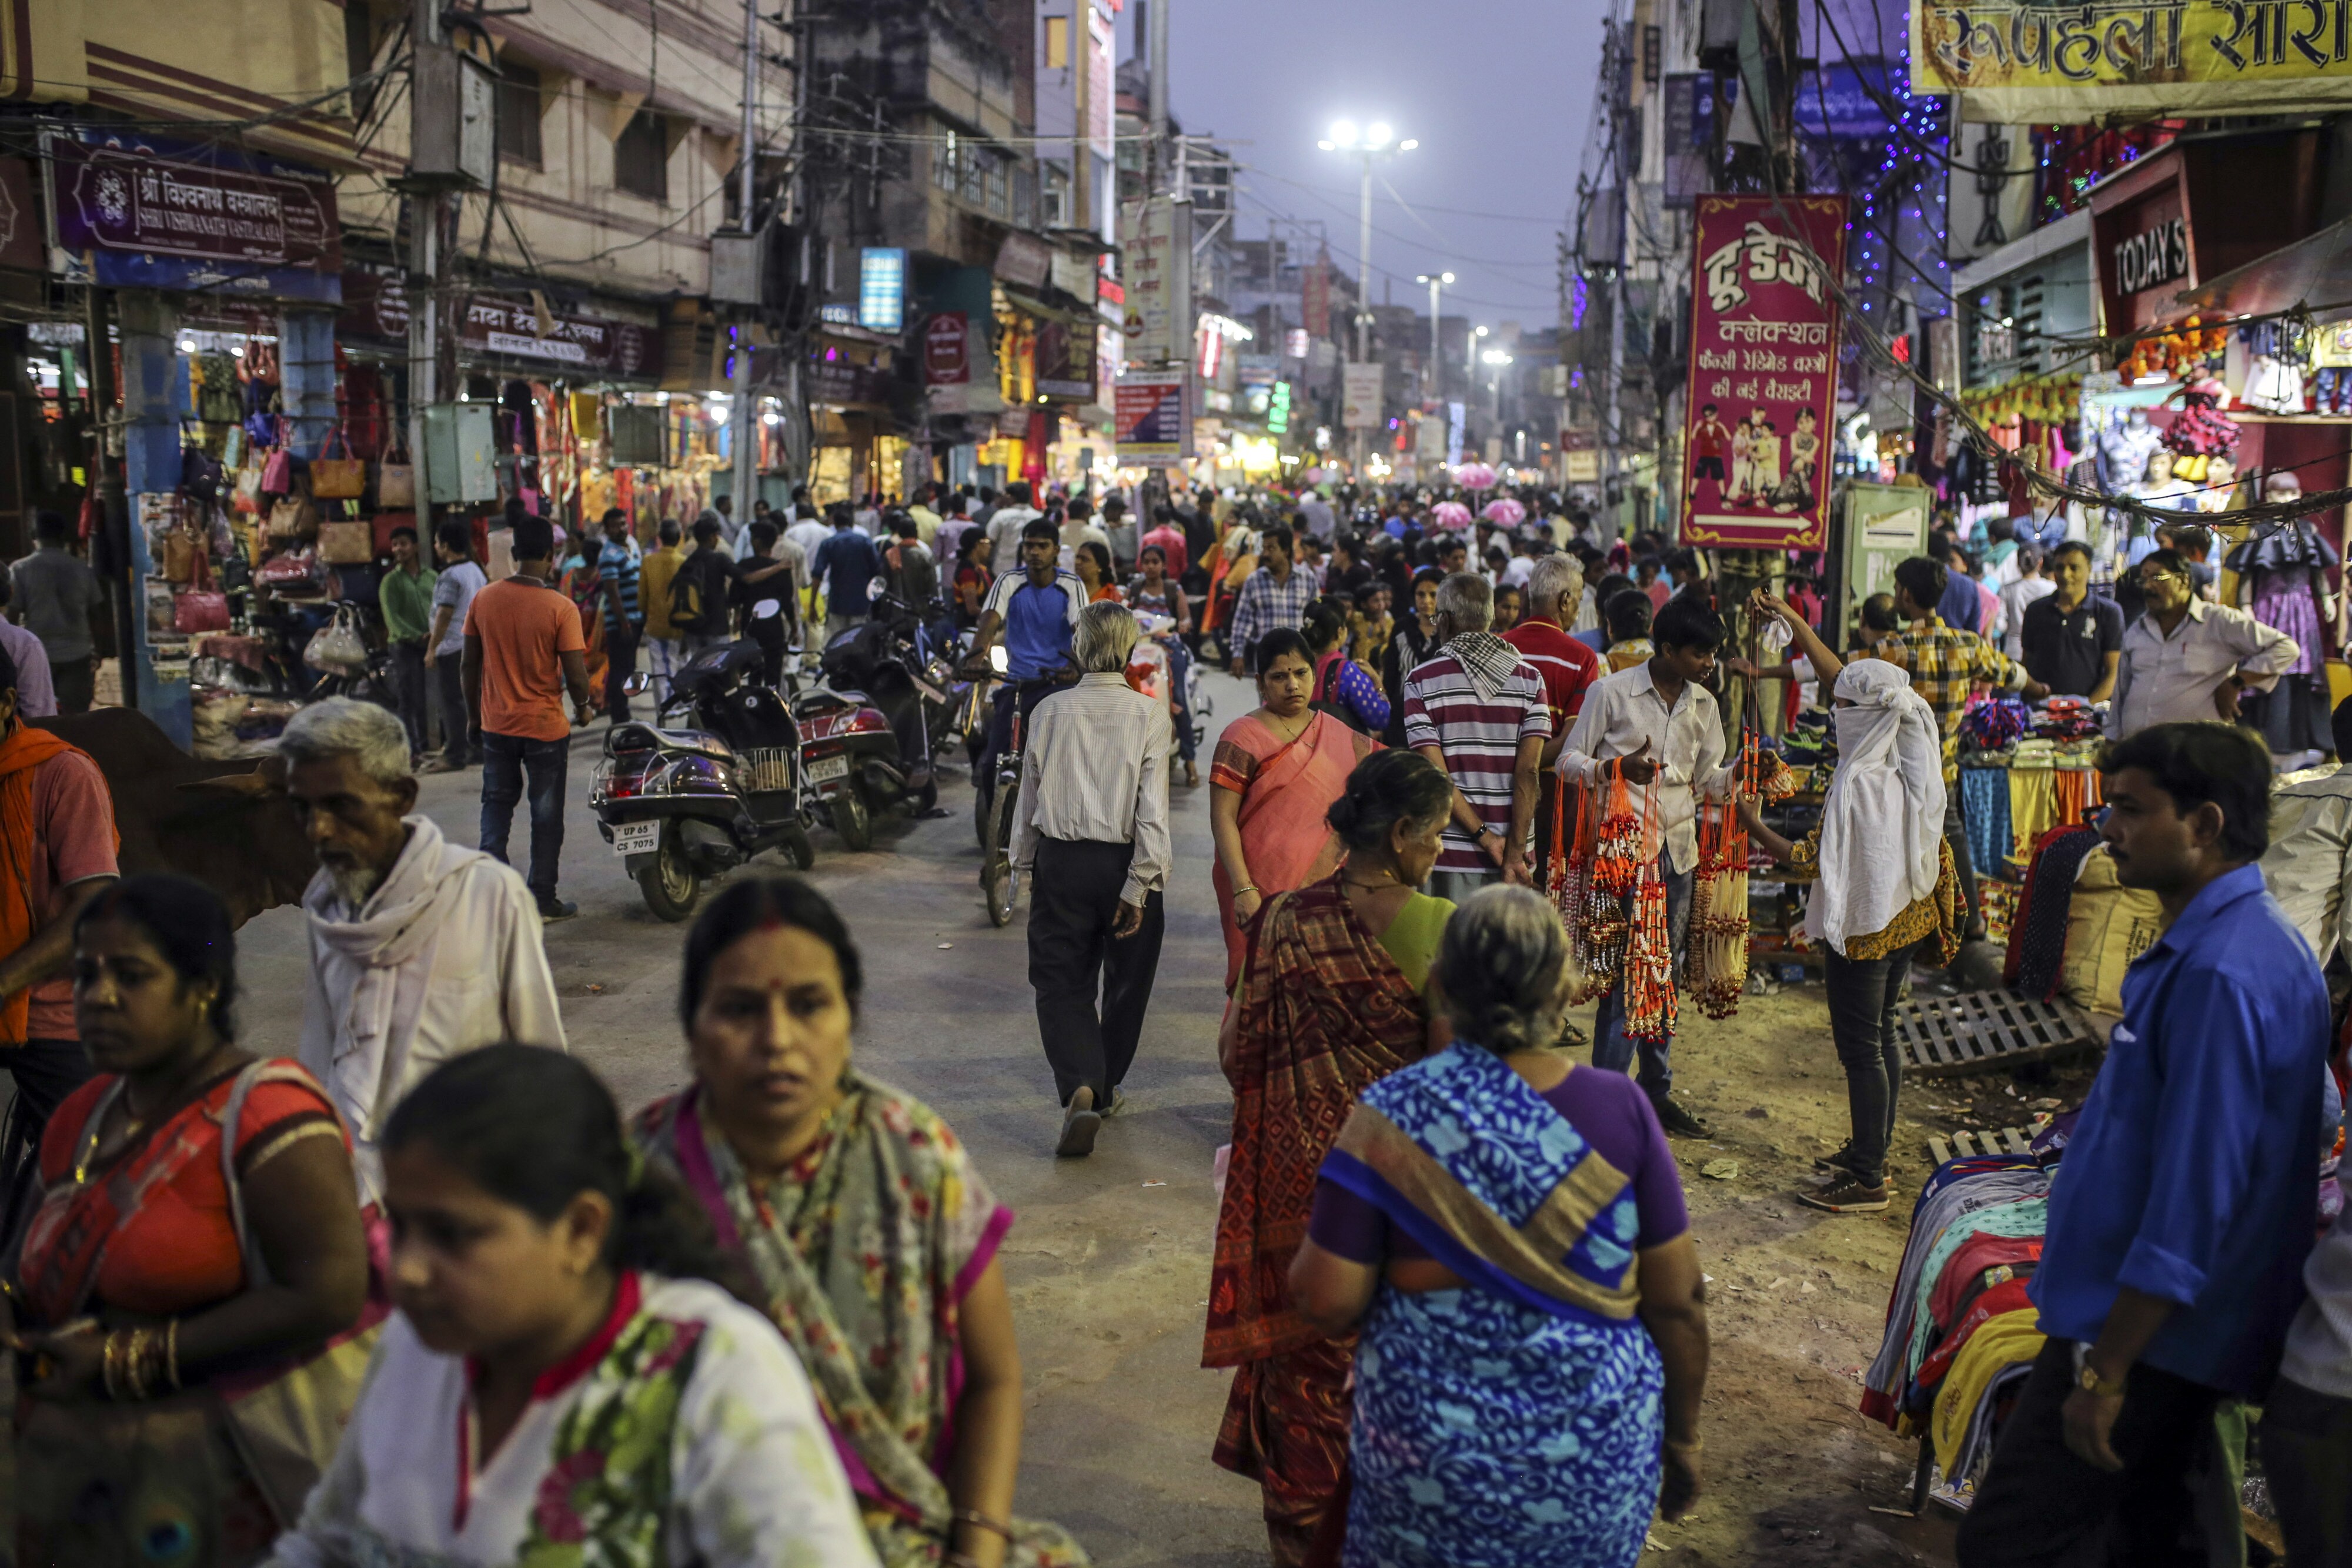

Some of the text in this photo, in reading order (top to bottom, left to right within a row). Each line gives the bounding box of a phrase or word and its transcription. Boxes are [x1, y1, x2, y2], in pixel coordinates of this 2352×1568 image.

[1719, 313, 1830, 345] क्लेक्शन
[1712, 376, 1730, 399] की
[1736, 377, 1758, 401] नई
[624, 825, 648, 835] UP 65
[617, 839, 654, 851] CS 7075
